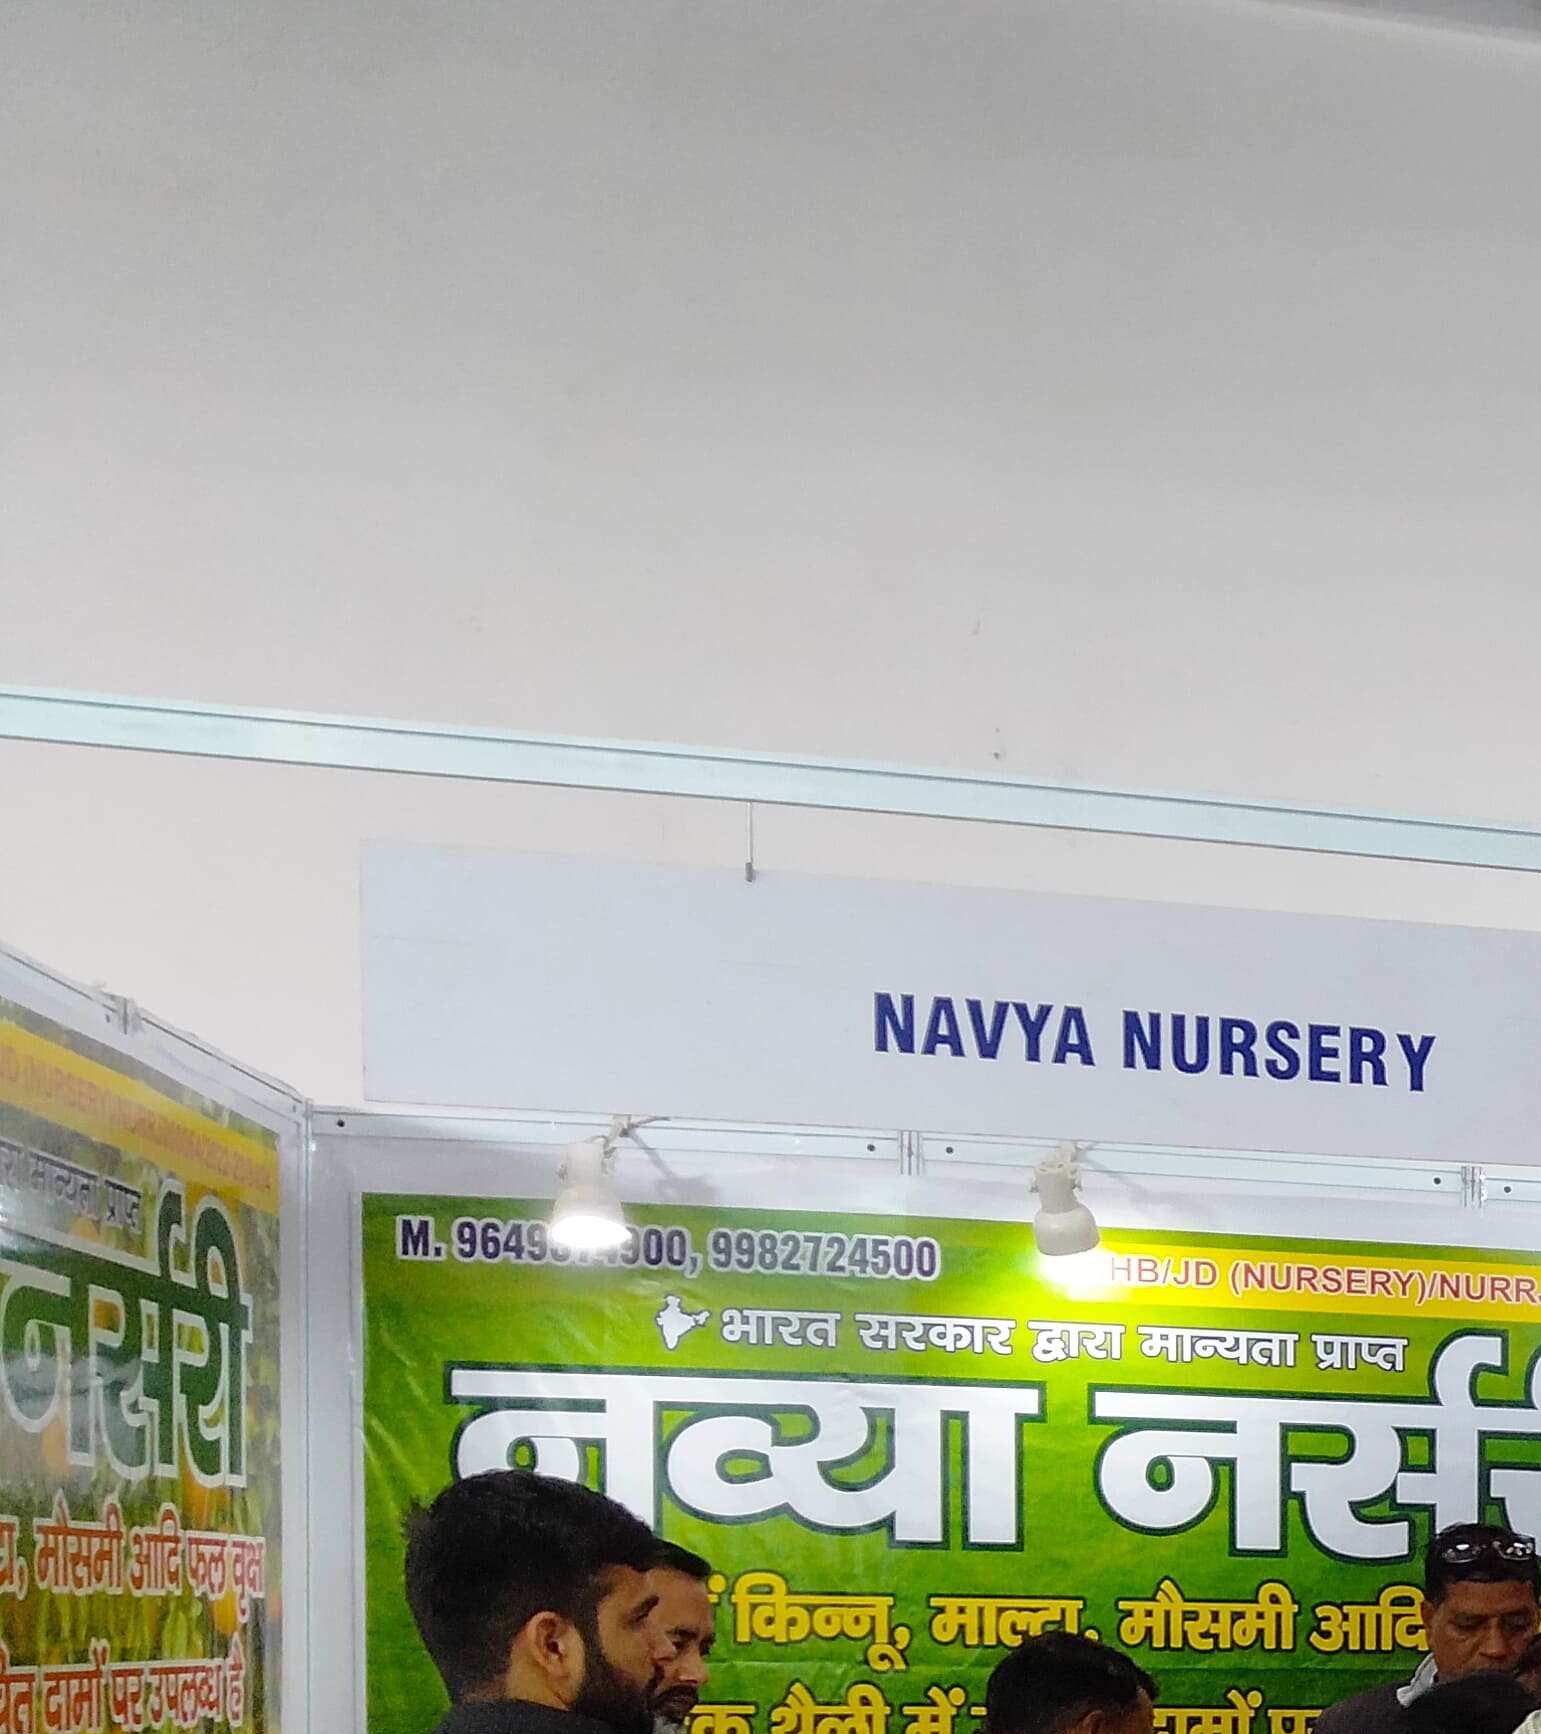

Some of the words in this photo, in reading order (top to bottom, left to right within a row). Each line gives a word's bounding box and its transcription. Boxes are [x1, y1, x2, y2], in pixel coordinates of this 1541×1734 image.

[873, 991, 1096, 1067] NAVYA
[1122, 1009, 1437, 1093] NURSERY
[401, 1219, 442, 1258] M.
[456, 1220, 699, 1275] 9649900,
[711, 1232, 937, 1279] 9982724500
[719, 1308, 841, 1349] भारत
[857, 1311, 1017, 1355] सरकार
[1028, 1320, 1126, 1363] द्वारा
[1137, 1325, 1299, 1368] मान्यता
[1311, 1334, 1409, 1371] प्राप्त
[450, 1367, 1040, 1543] नव्या
[34, 1490, 124, 1595] मौसमी
[129, 1503, 182, 1596] आदि
[186, 1533, 228, 1598] फल
[732, 1571, 911, 1673] किन्नू,
[1118, 1580, 1299, 1652] मौसमी
[1308, 1584, 1431, 1653] आदि
[109, 1667, 146, 1732] पर
[148, 1659, 224, 1730] उपलब्ध
[226, 1633, 245, 1728] है
